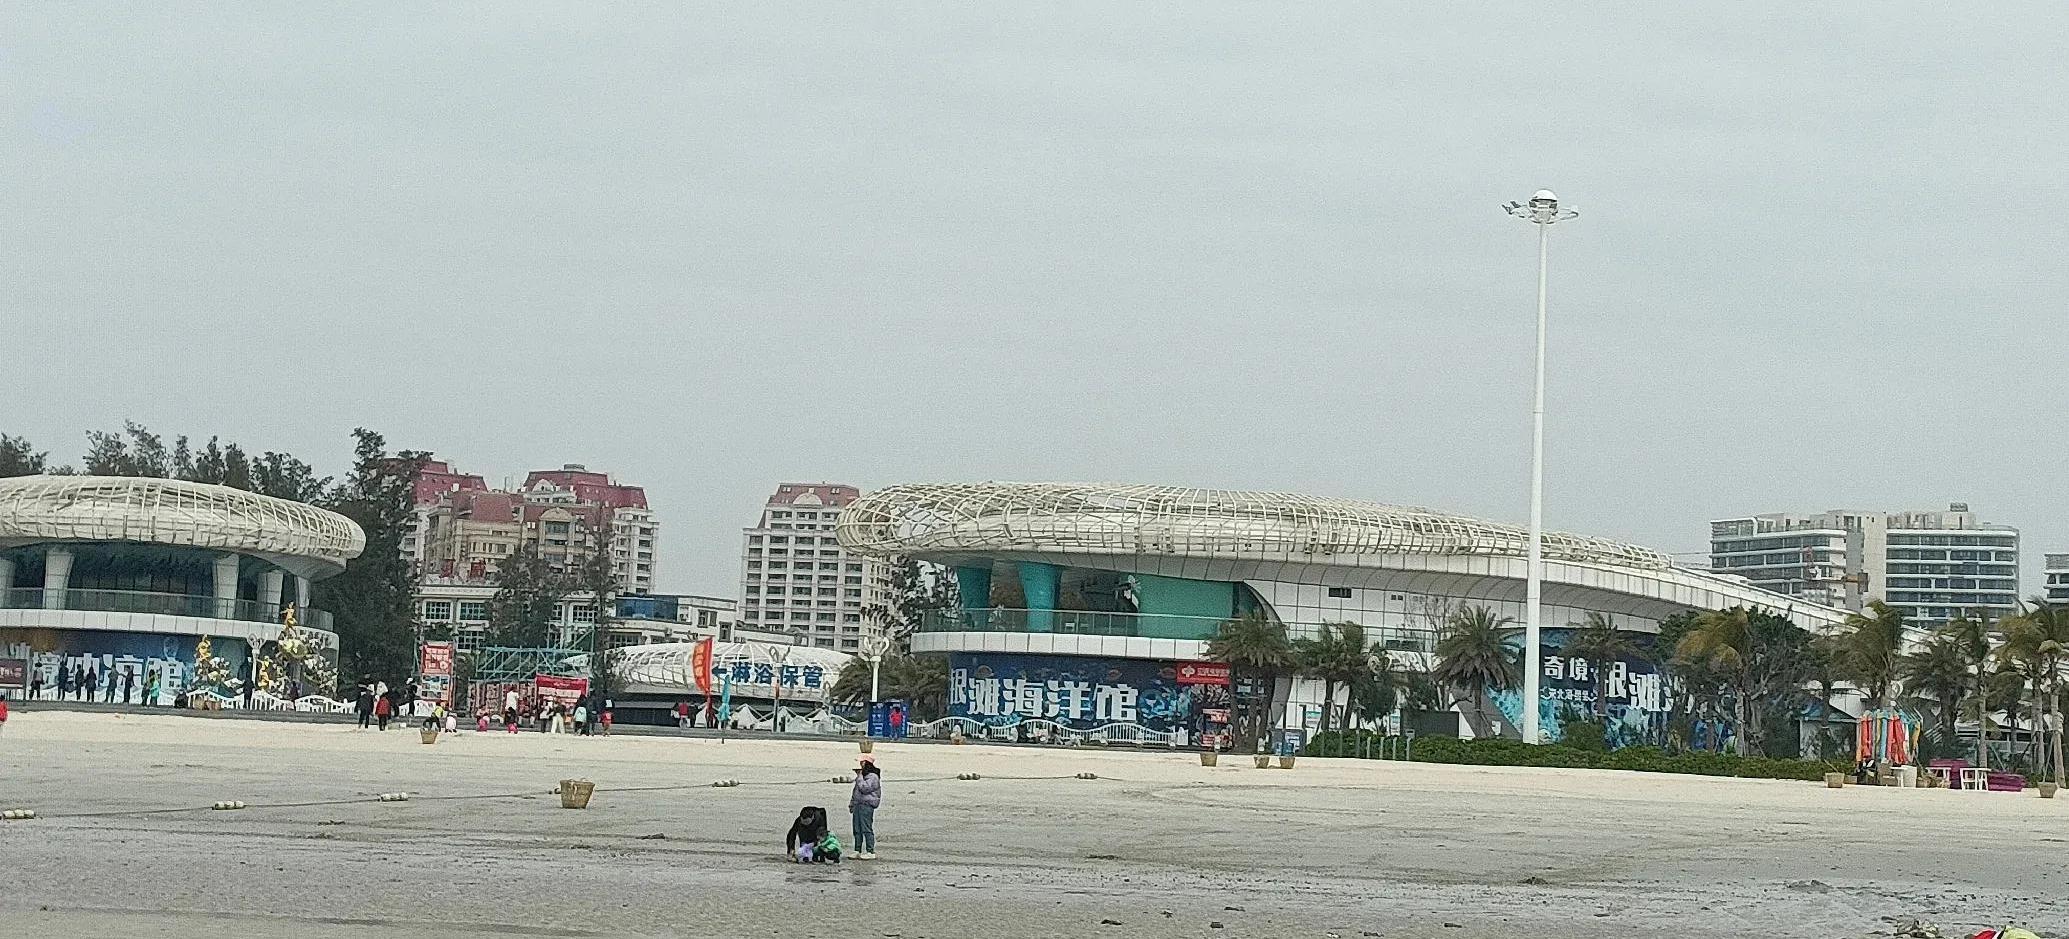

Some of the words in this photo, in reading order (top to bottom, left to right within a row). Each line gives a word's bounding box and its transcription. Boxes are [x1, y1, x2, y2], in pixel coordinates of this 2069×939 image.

[732, 661, 824, 689] 淋浴保管
[950, 668, 1139, 722] 银滩海洋馆
